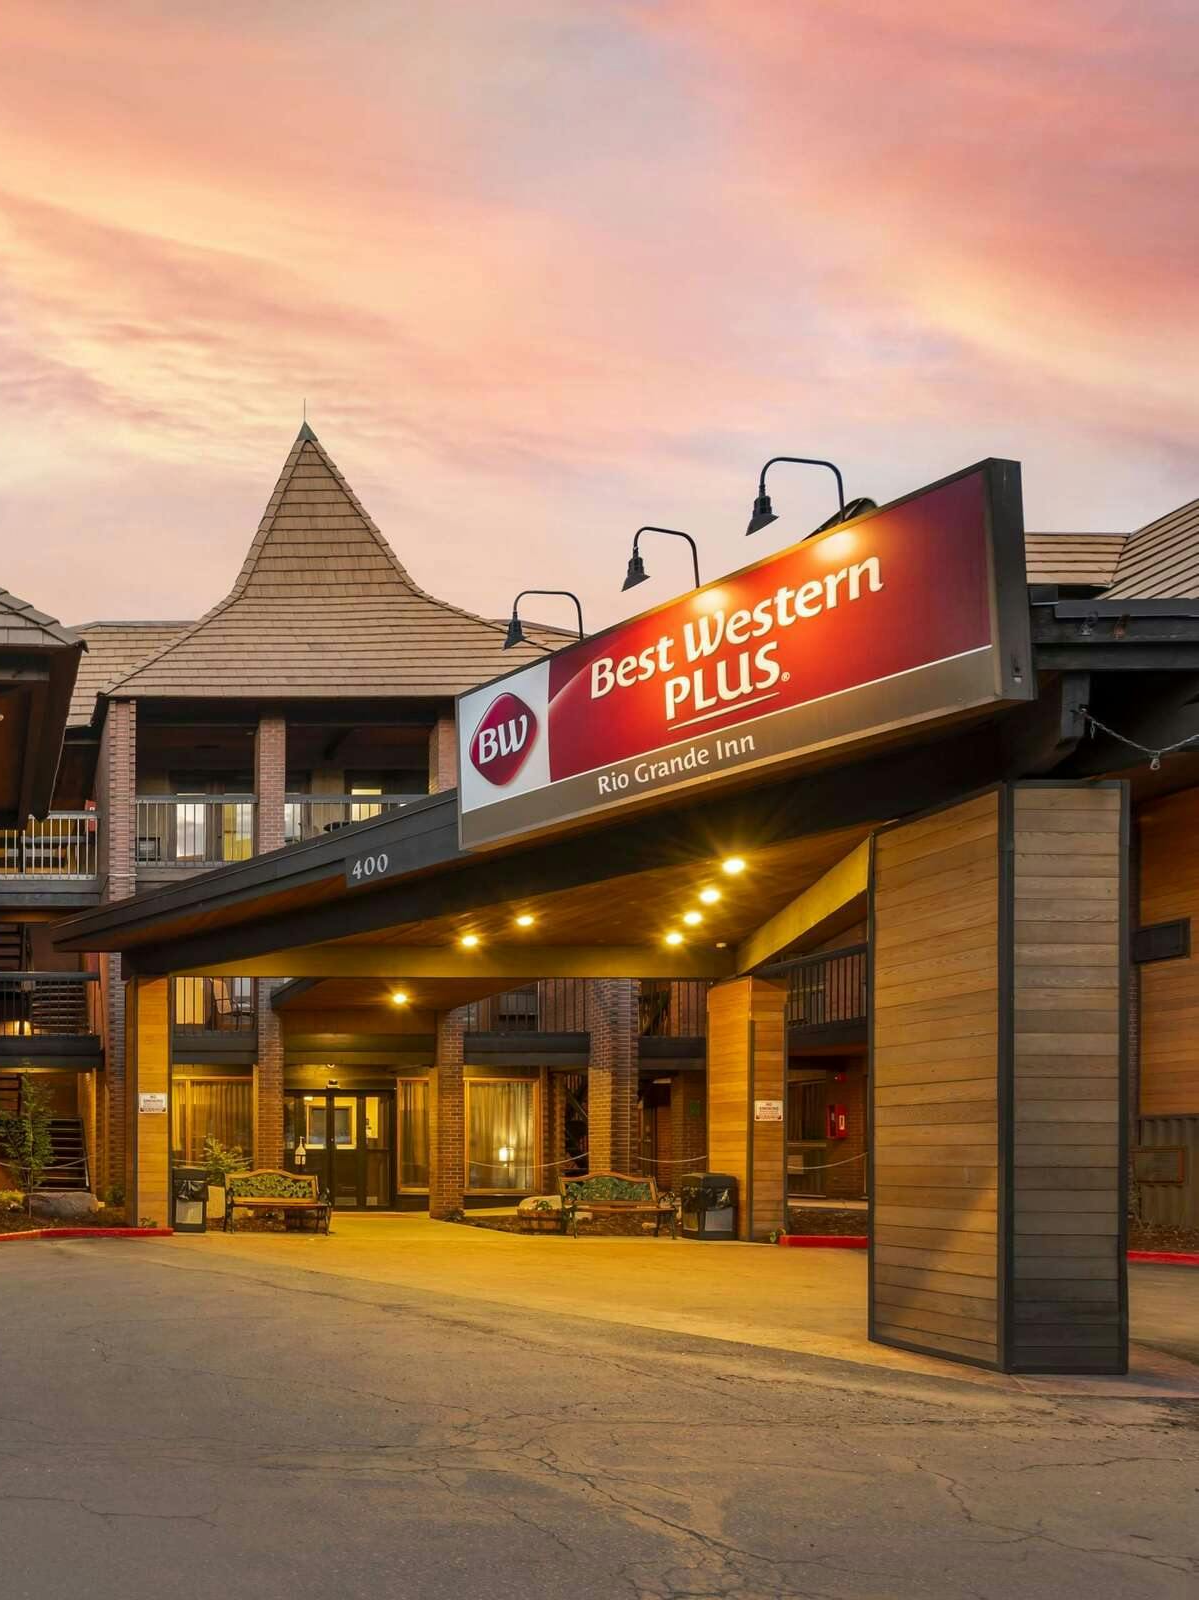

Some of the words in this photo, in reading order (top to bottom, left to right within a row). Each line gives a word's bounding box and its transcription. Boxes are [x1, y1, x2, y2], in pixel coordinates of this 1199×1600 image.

[590, 635, 675, 699] Best
[682, 555, 884, 663] Western
[478, 714, 528, 765] BW
[597, 772, 630, 795] Rio
[634, 747, 710, 783] Grande
[715, 734, 756, 760] Inn
[352, 853, 389, 880] 400
